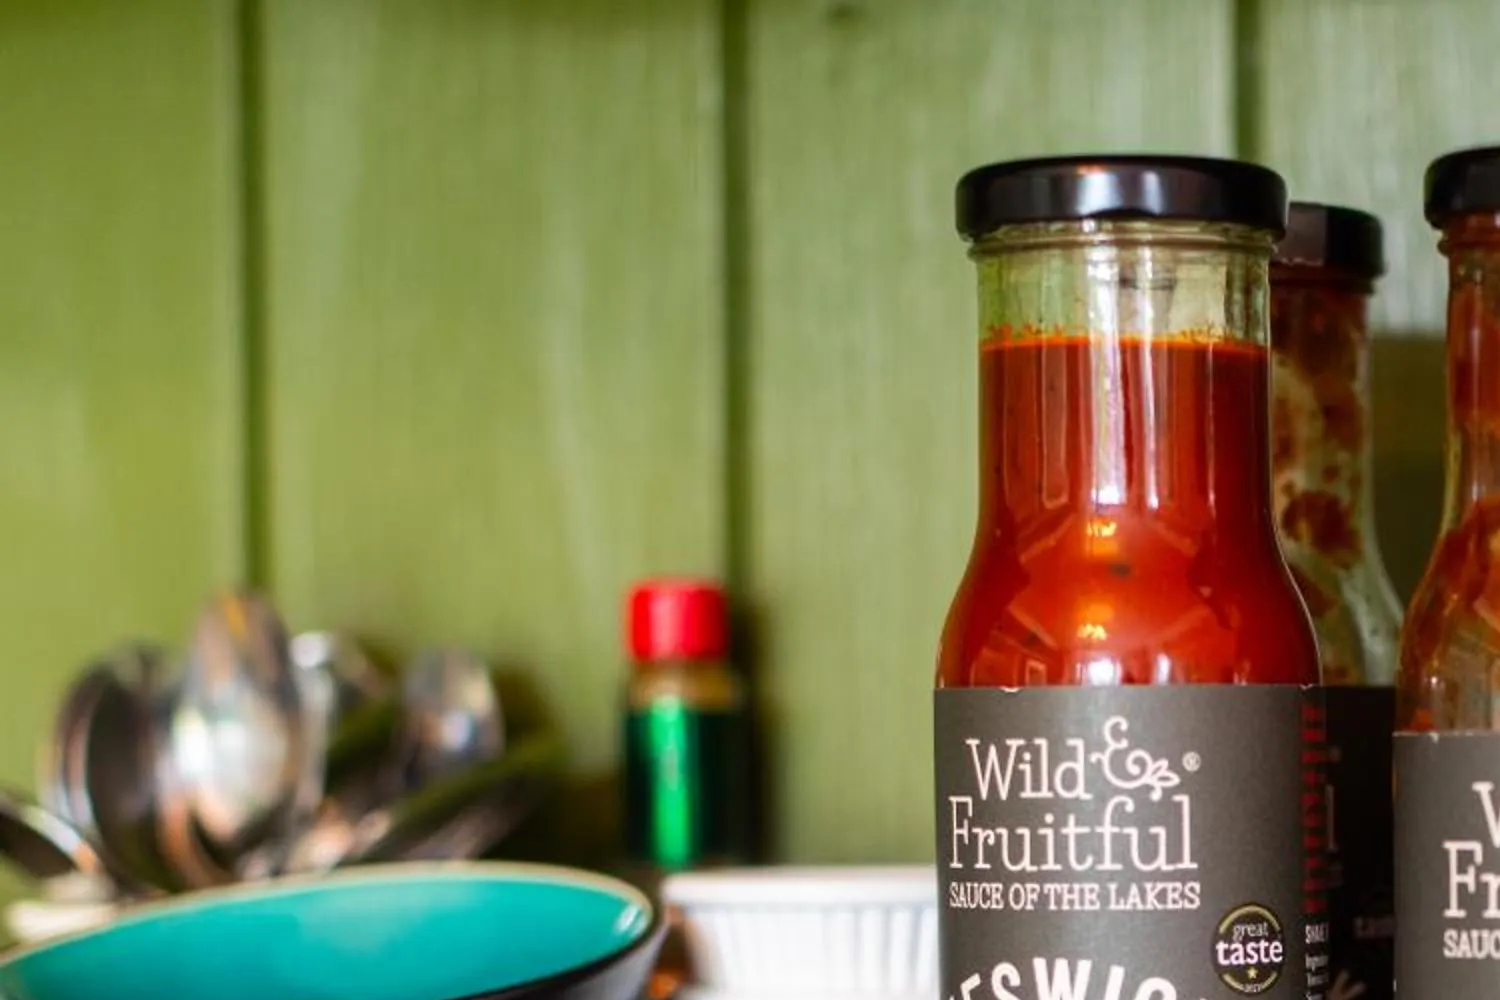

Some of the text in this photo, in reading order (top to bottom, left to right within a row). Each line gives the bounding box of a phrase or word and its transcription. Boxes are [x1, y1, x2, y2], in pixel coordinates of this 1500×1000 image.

[966, 738, 1093, 799] Wild
[949, 795, 1198, 871] Fruitful
[949, 881, 1201, 910] SAUCE OF THE LAKES
[1232, 922, 1269, 941] great
[1215, 939, 1283, 966] taste
